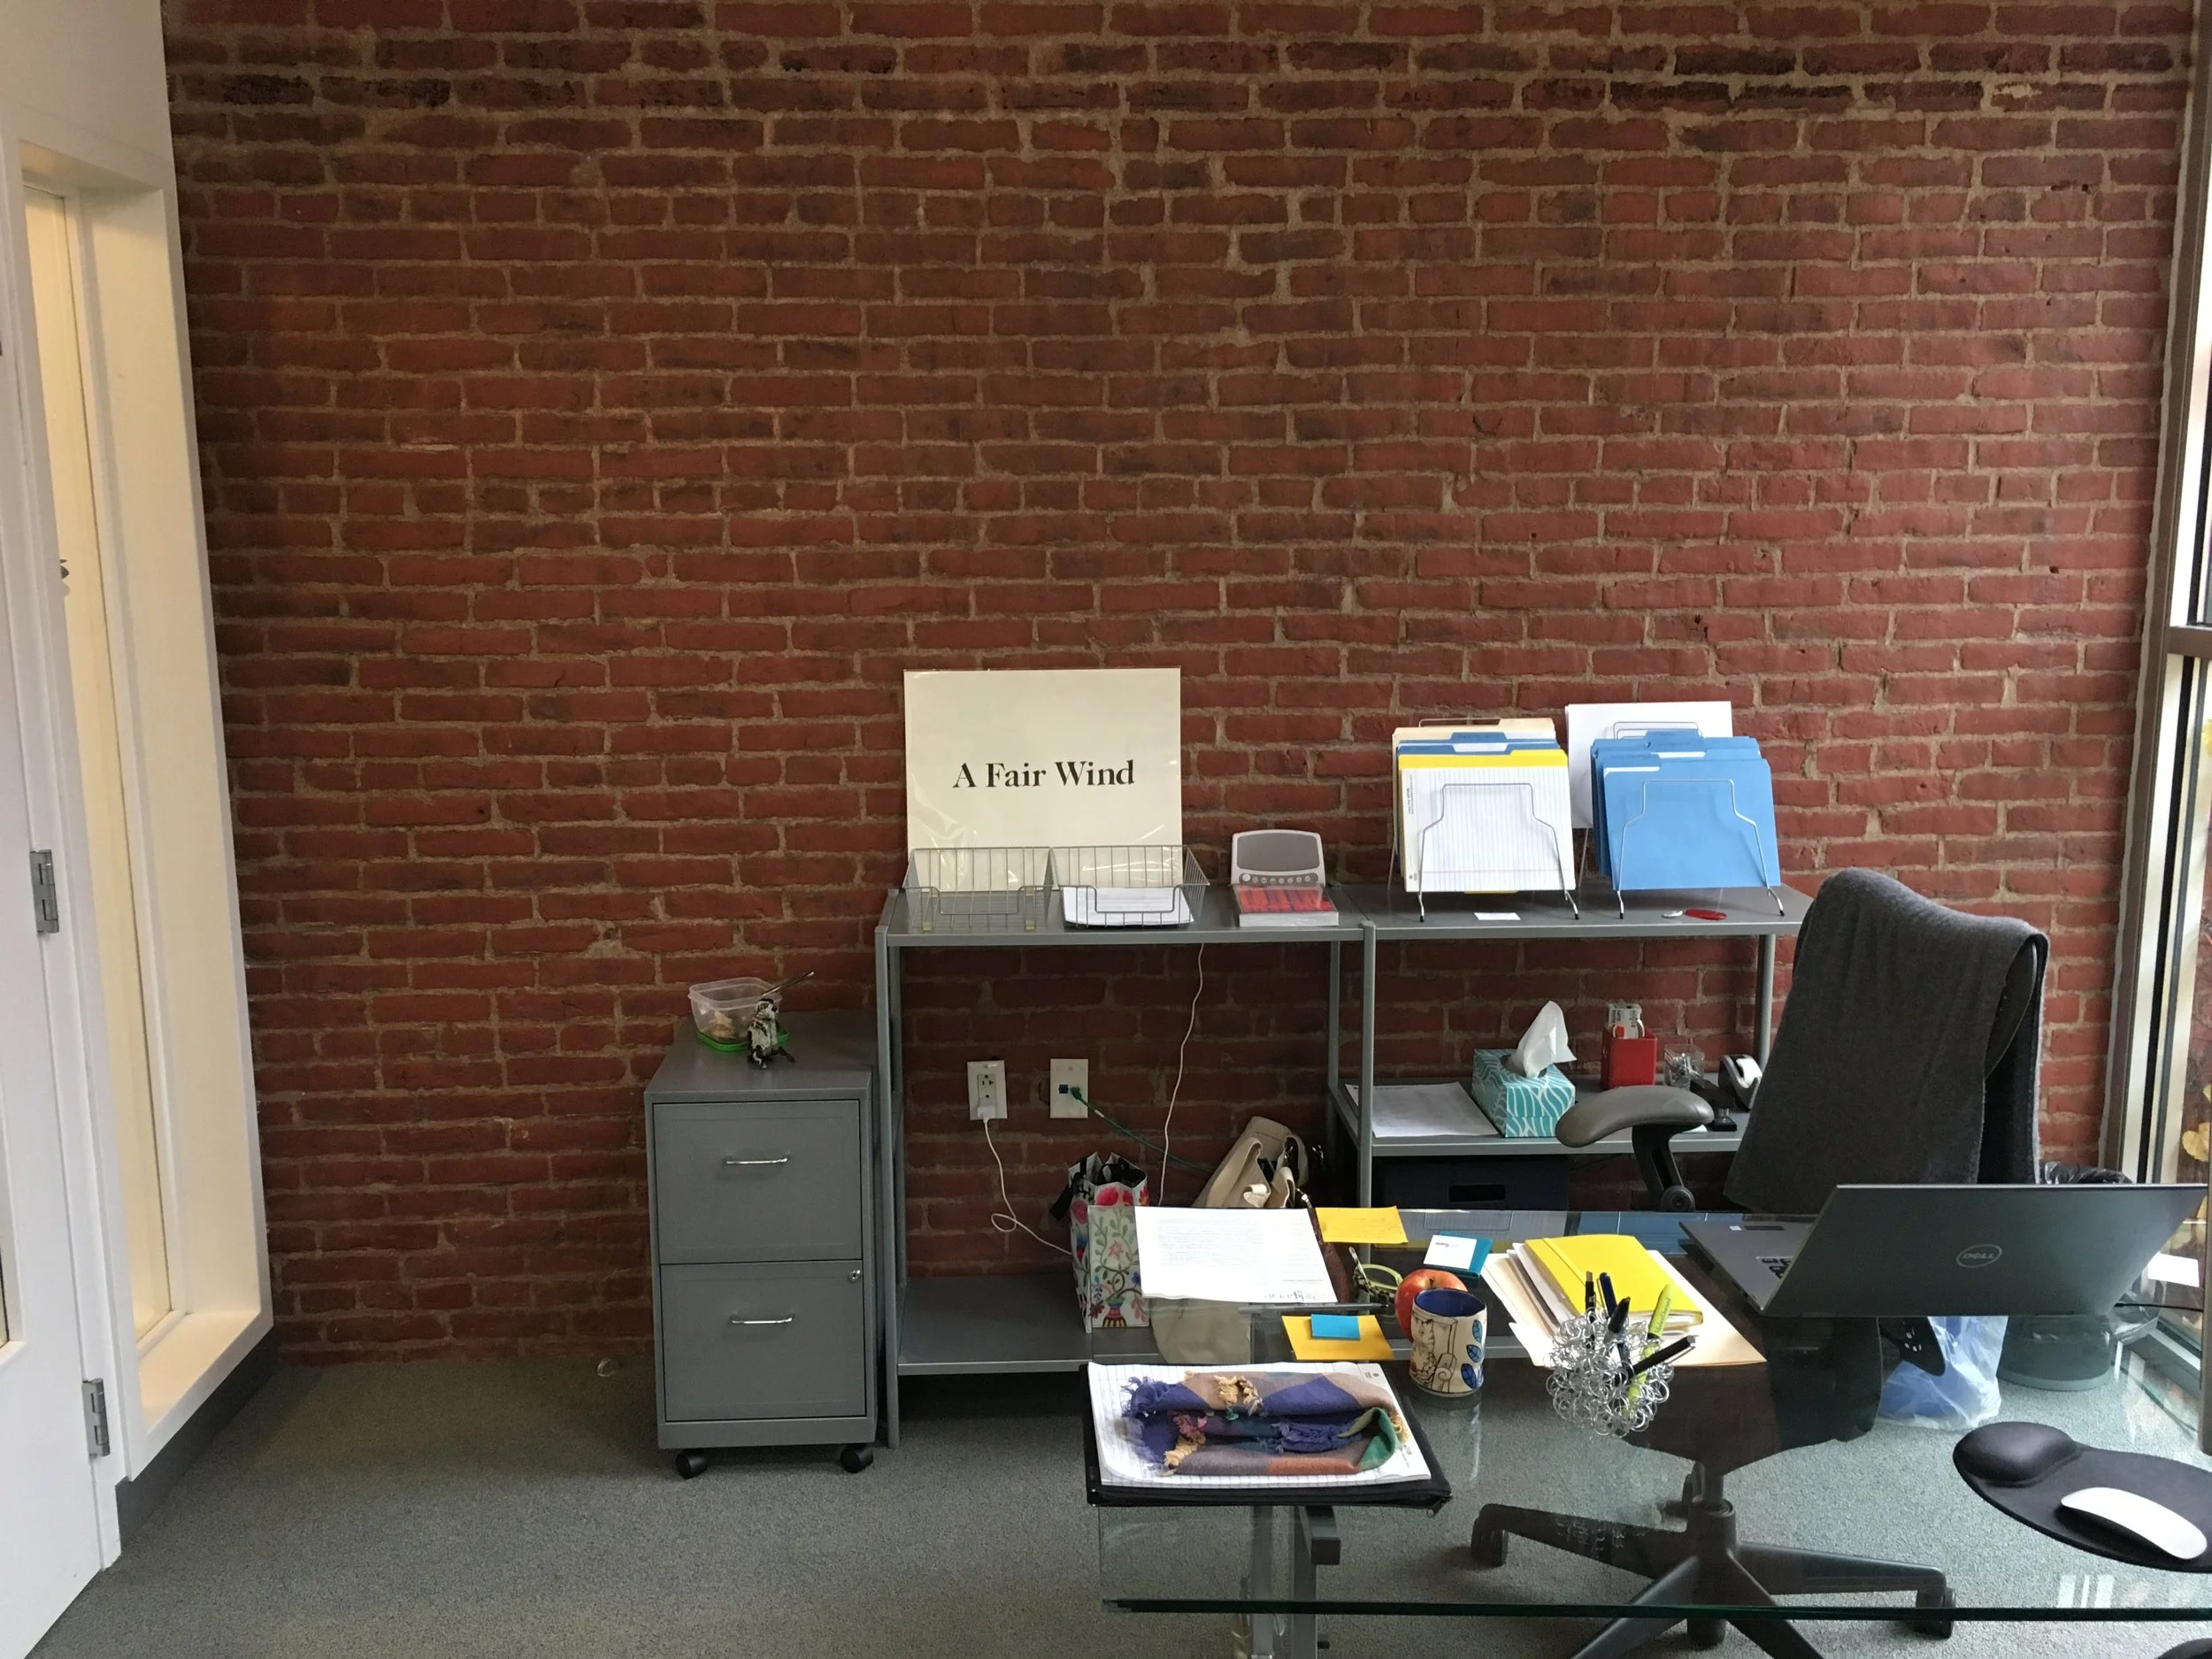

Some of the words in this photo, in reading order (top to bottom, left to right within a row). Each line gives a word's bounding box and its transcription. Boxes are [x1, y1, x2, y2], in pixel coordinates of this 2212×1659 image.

[952, 762, 977, 788] A
[986, 762, 1047, 788] Fair
[1054, 759, 1135, 787] Wind
[1962, 1252, 1994, 1261] DELL
